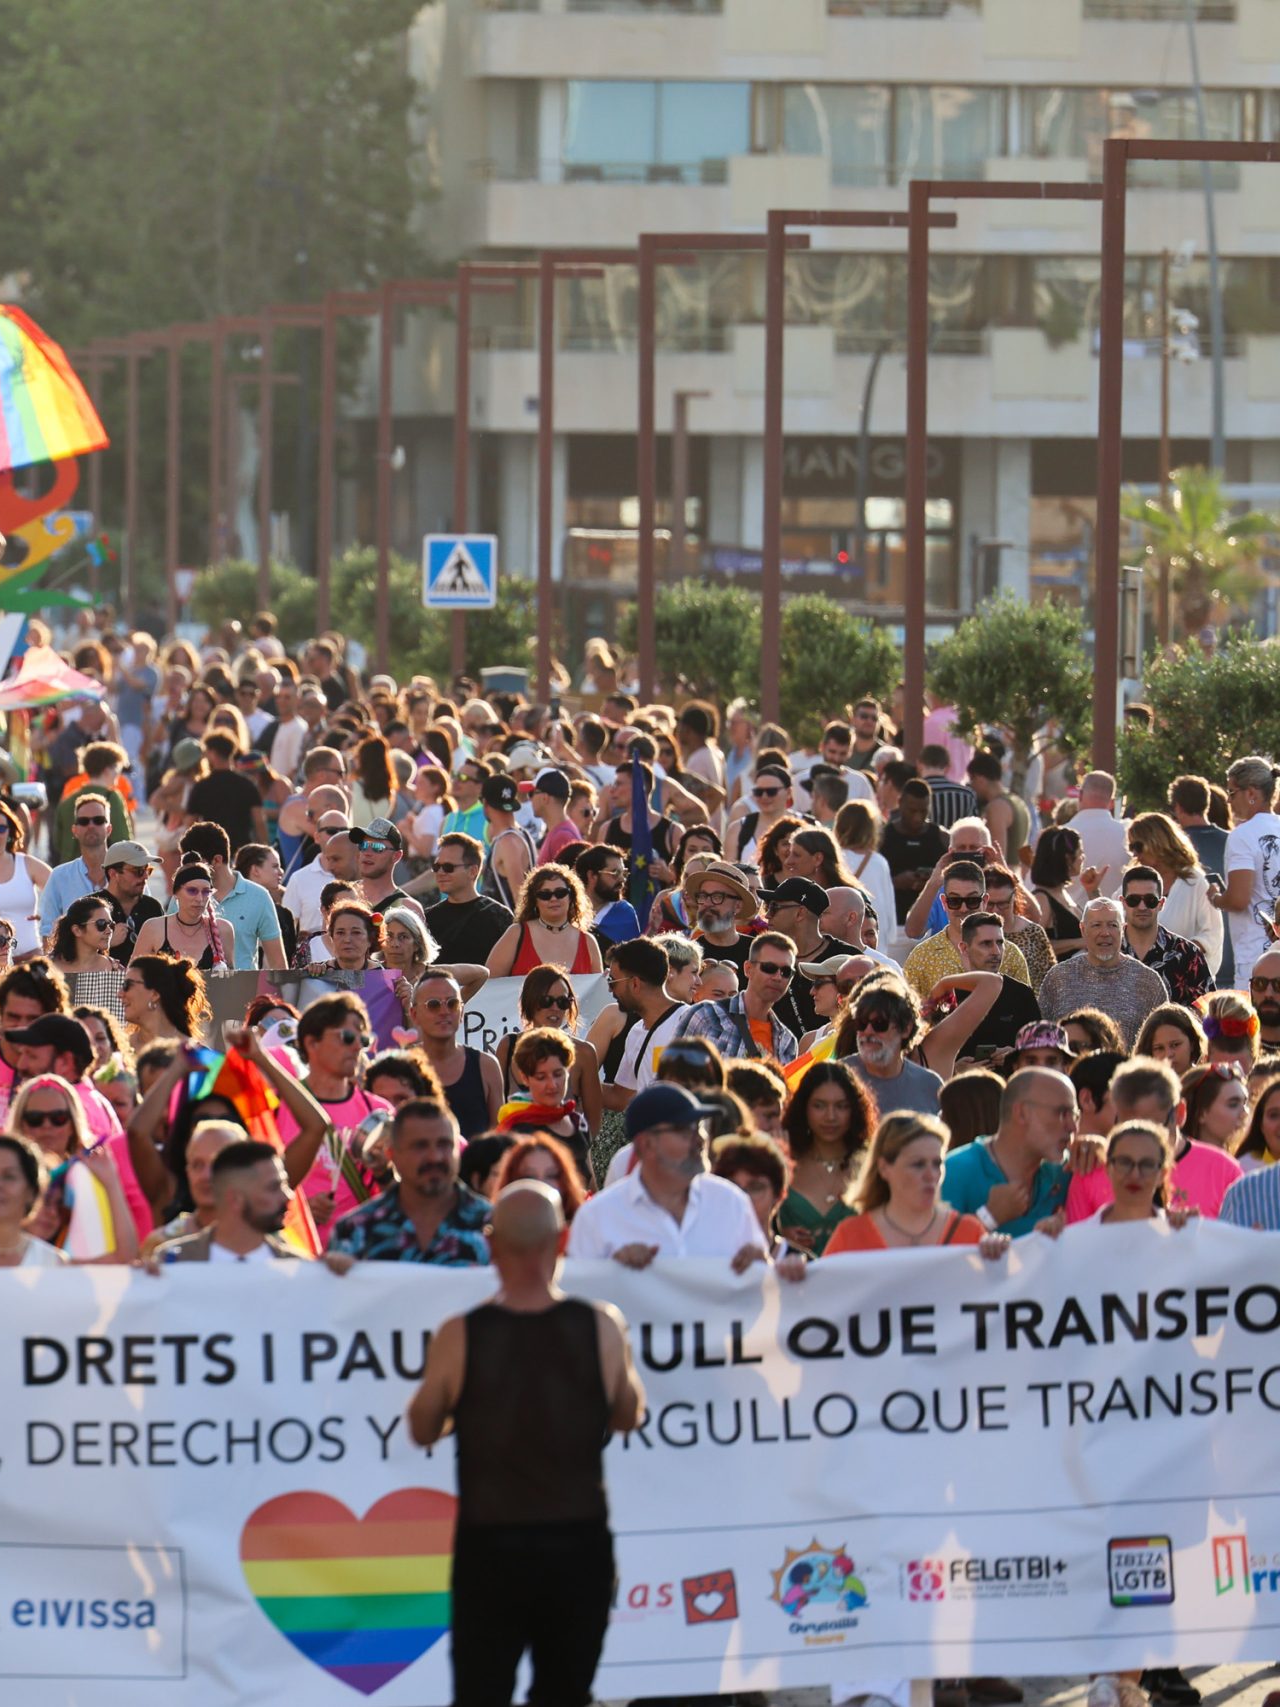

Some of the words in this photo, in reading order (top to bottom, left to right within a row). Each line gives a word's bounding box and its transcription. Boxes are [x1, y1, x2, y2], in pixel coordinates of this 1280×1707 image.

[23, 1333, 237, 1386] DRETS
[263, 1333, 274, 1384] I
[302, 1330, 431, 1383] PAU
[787, 1304, 937, 1359] QUE
[961, 1284, 1280, 1350] TRANSFO
[27, 1416, 346, 1466] DERECHOS
[366, 1415, 402, 1460] Y
[600, 1392, 858, 1451] RGULLO
[881, 1385, 1009, 1434] QUE
[950, 1556, 1067, 1582] FELGTBI+
[1114, 1552, 1165, 1568] IBIZA
[1114, 1570, 1167, 1591] LGTB
[12, 1598, 157, 1628] eivissa
